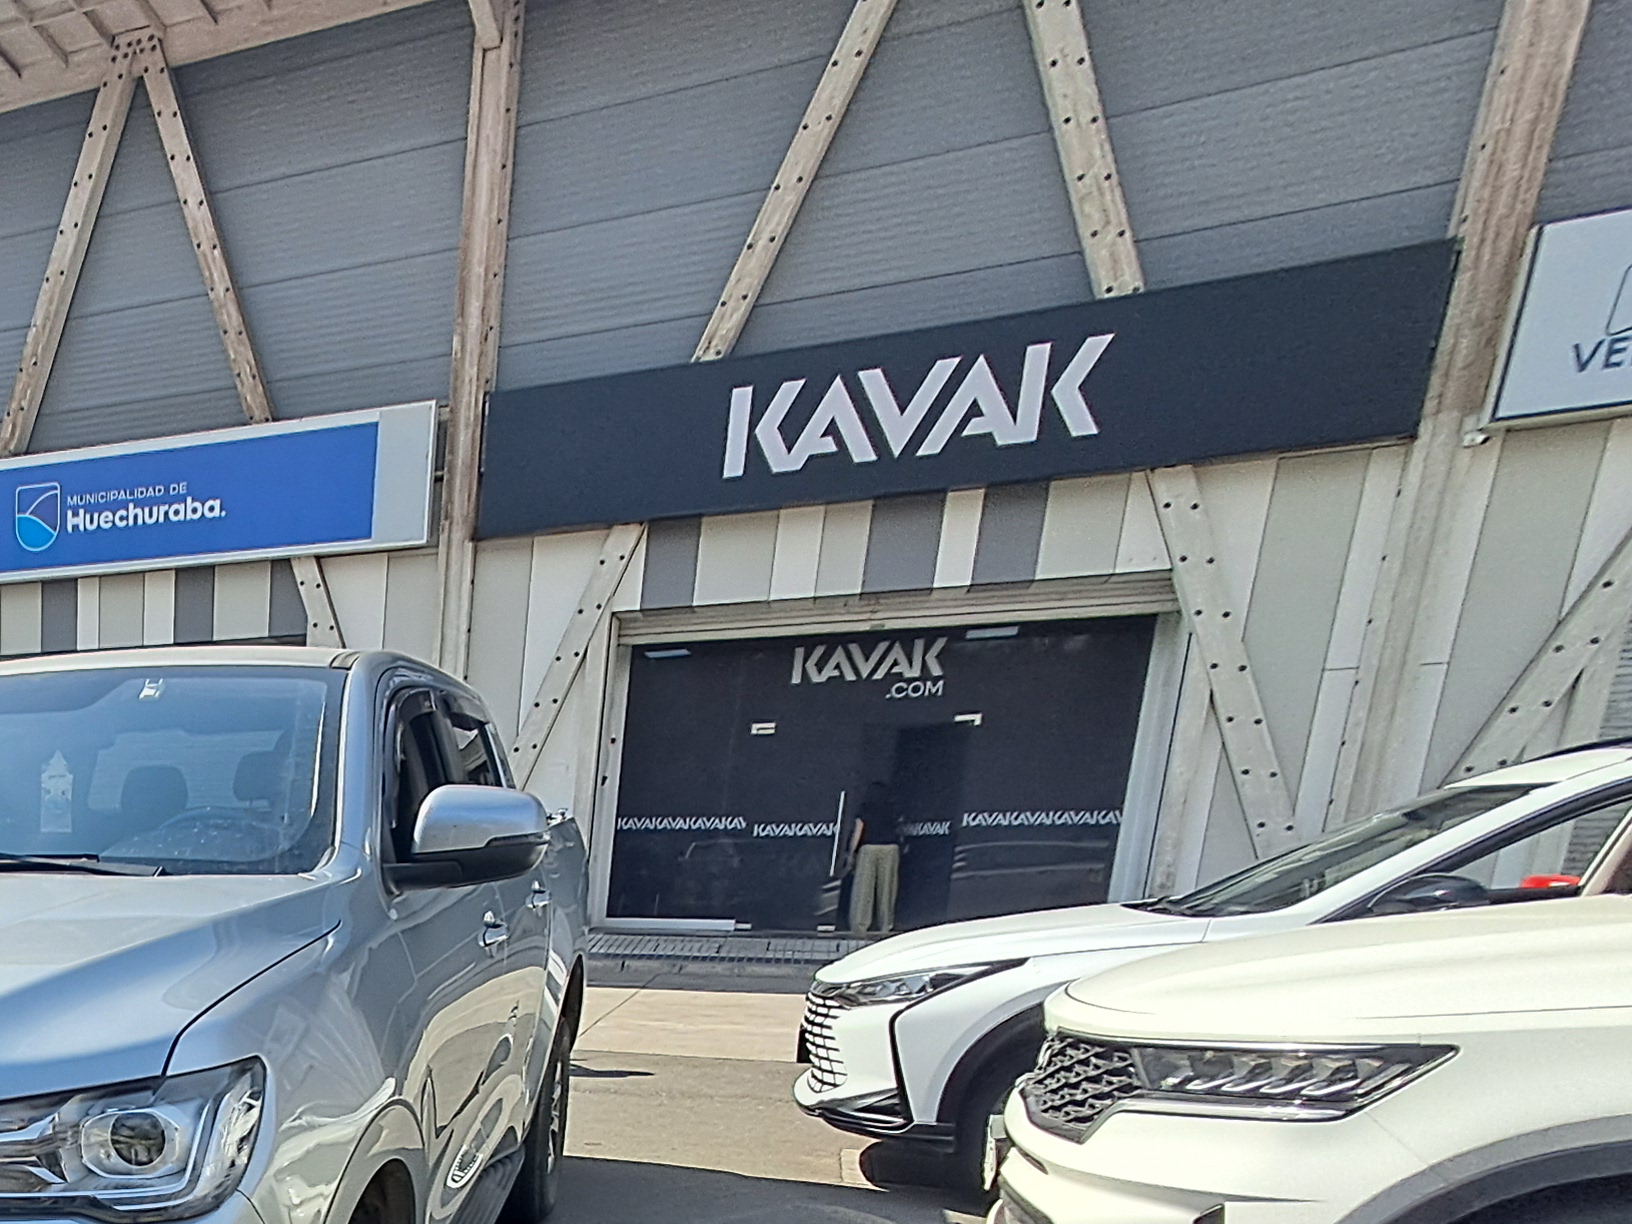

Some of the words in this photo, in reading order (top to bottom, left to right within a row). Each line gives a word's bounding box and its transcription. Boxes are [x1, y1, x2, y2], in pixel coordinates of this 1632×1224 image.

[1573, 336, 1632, 373] VE
[722, 332, 1116, 479] KAVAK
[67, 485, 165, 507] MUNICIPALIDAD
[170, 481, 188, 495] DE
[791, 636, 948, 684] KAVAK
[885, 680, 945, 699] .COM
